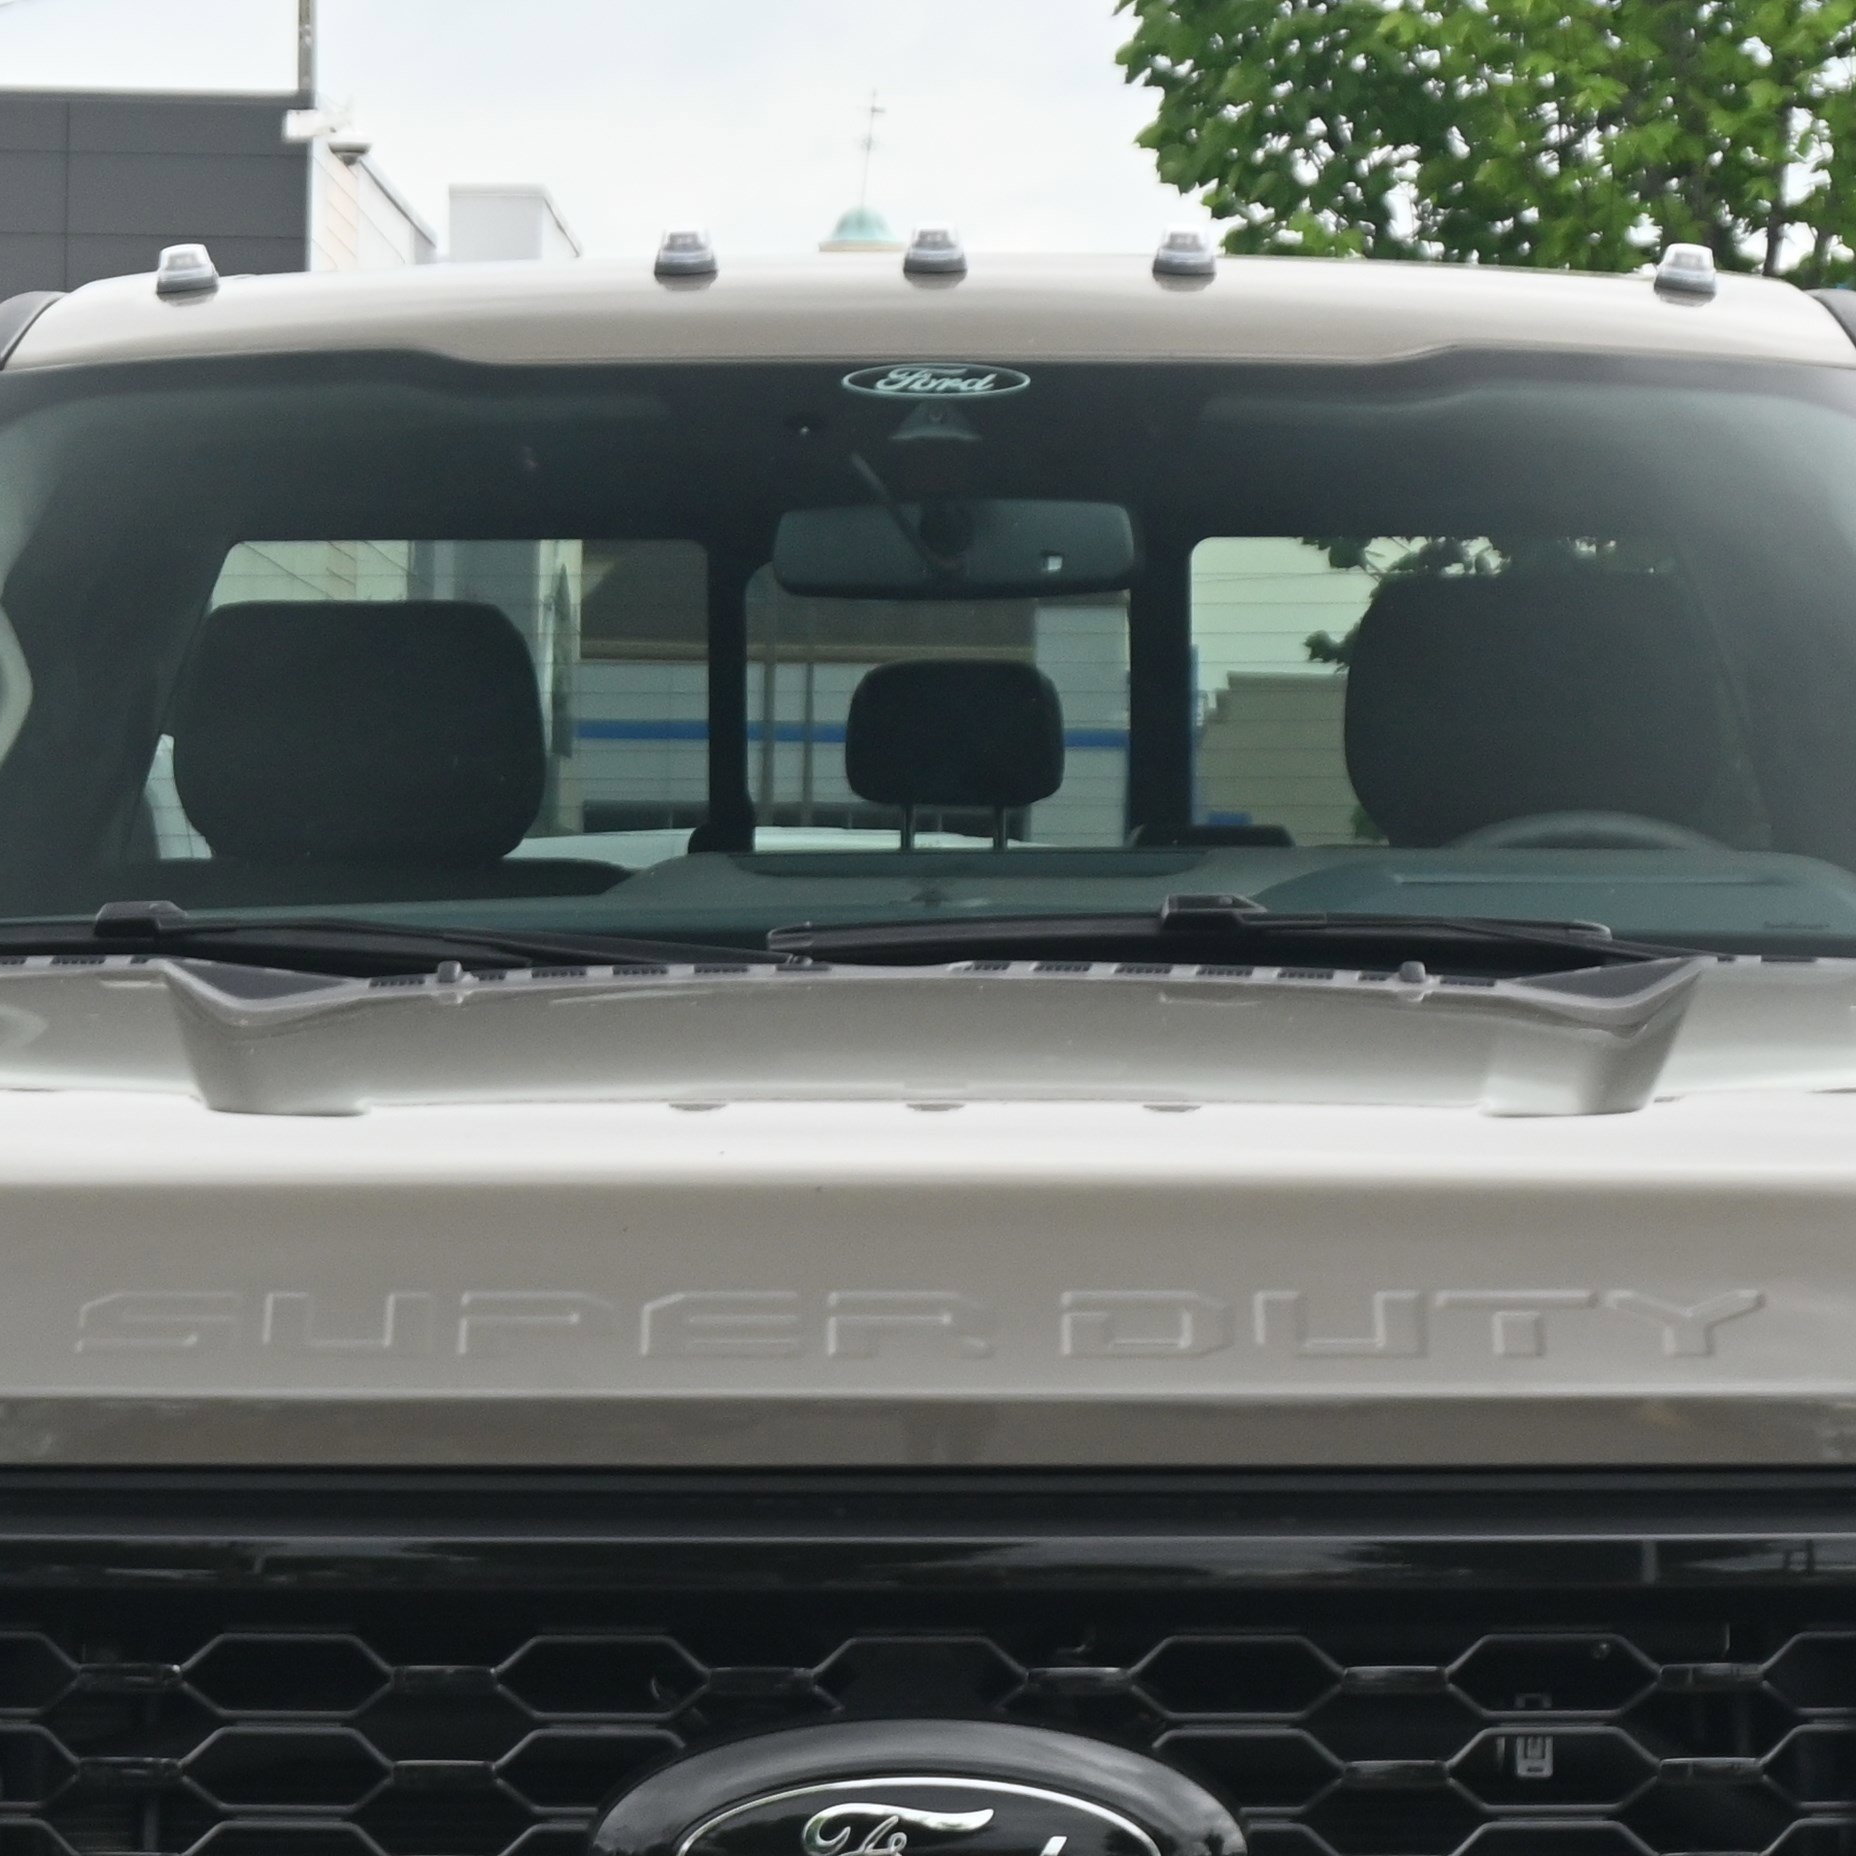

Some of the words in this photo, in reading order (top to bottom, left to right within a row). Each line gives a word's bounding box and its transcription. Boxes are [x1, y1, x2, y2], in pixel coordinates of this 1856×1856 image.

[873, 366, 999, 392] Ford
[76, 1289, 993, 1358] SUPER
[1059, 1288, 1766, 1358] DUTY
